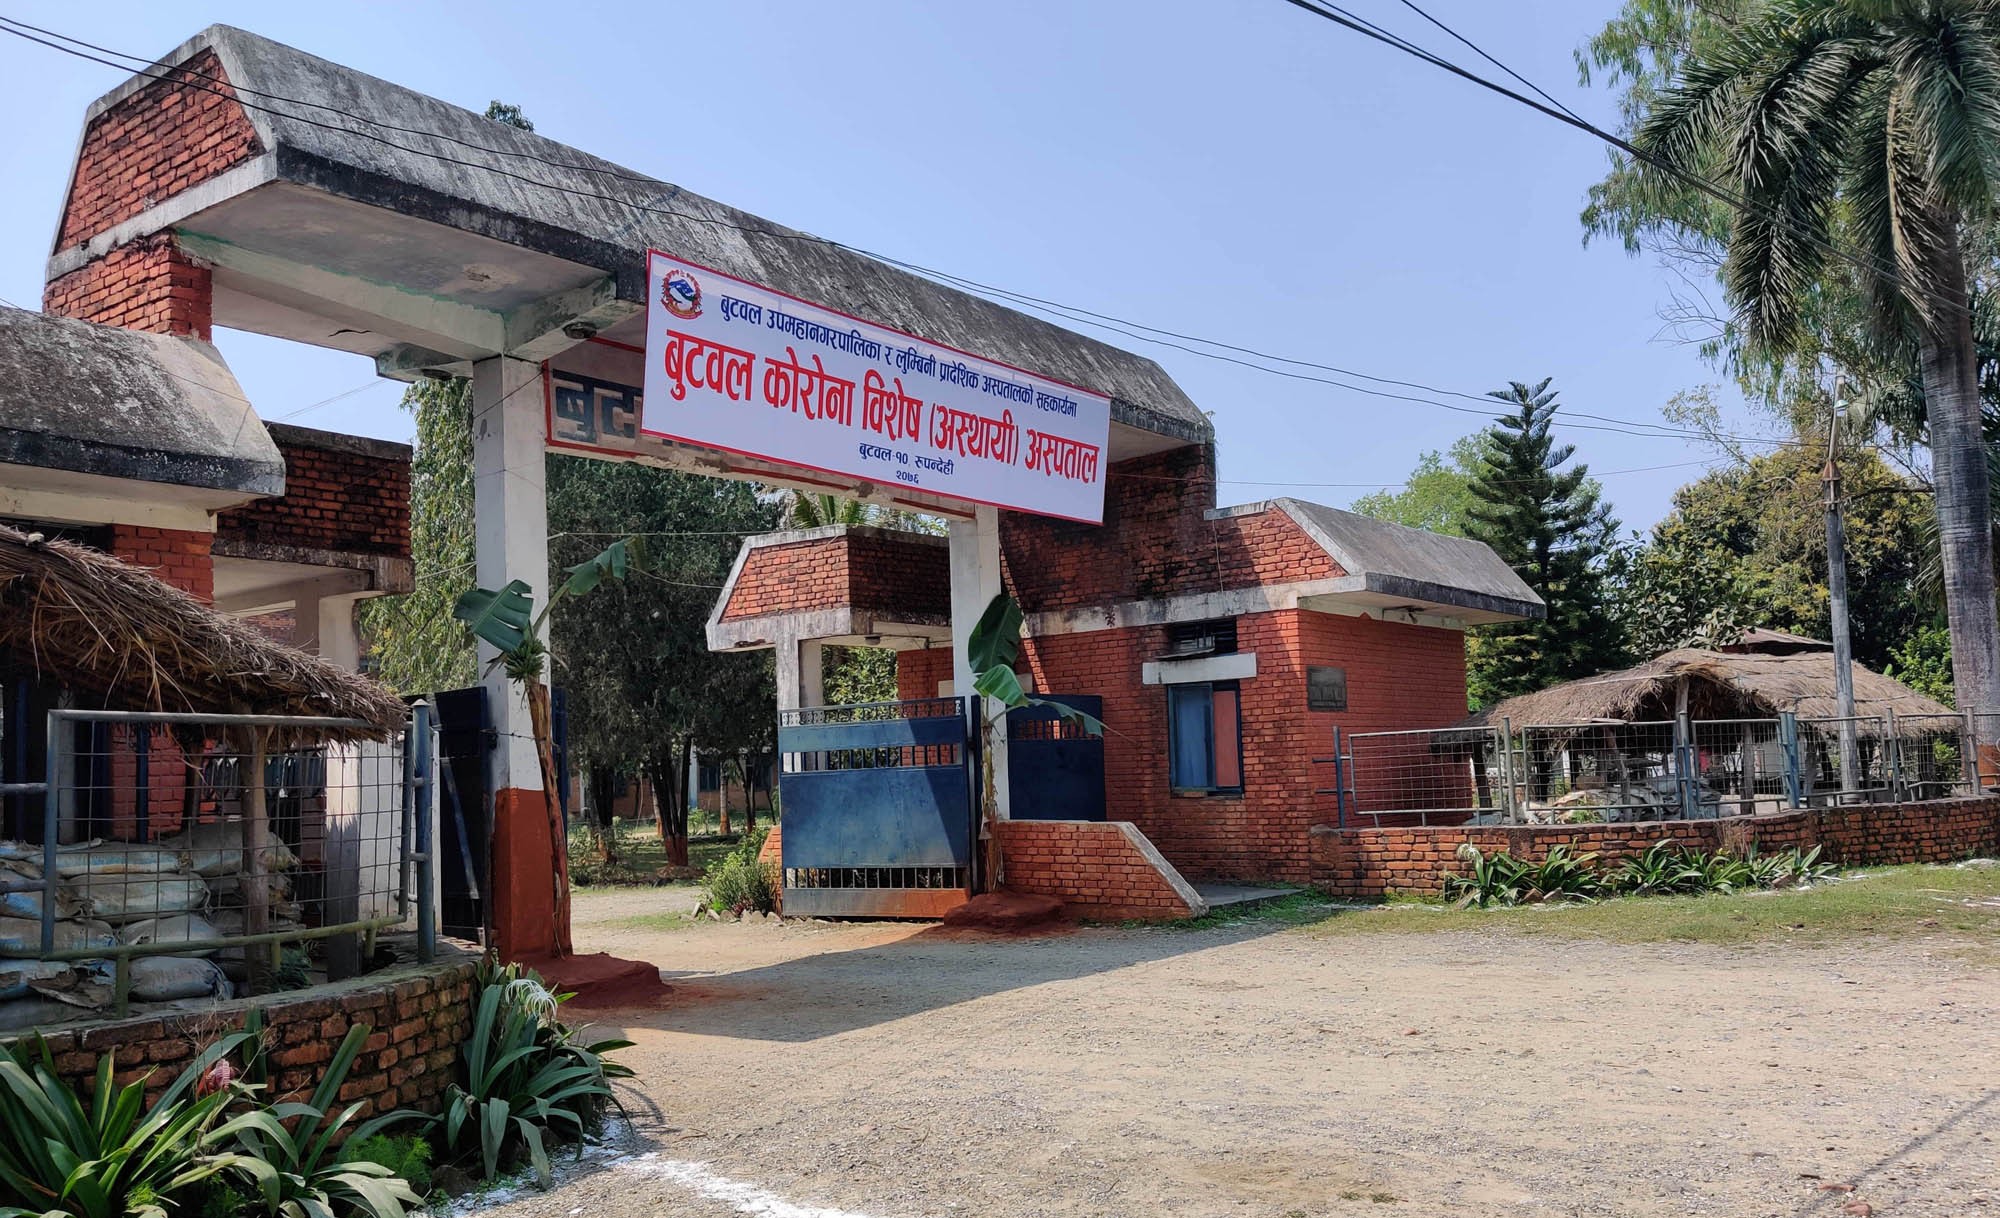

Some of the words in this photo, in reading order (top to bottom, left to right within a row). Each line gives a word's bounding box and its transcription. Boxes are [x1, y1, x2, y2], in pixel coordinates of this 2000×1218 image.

[664, 328, 756, 401] बुटवल
[764, 346, 856, 427] कोरोना
[862, 368, 923, 443] विशेष
[929, 403, 1020, 467] (अस्थायी)
[1025, 428, 1100, 484] अस्पताल
[720, 294, 763, 325] बुटवल
[766, 306, 881, 361] उपमहानगरपालिका
[884, 346, 894, 366] र
[896, 346, 936, 378] लुम्बिनी
[939, 360, 980, 389] प्रादेशिक
[982, 375, 1034, 406] अस्पतालको
[1036, 392, 1078, 418] सहकार्यमा
[895, 470, 920, 485] २०७६
